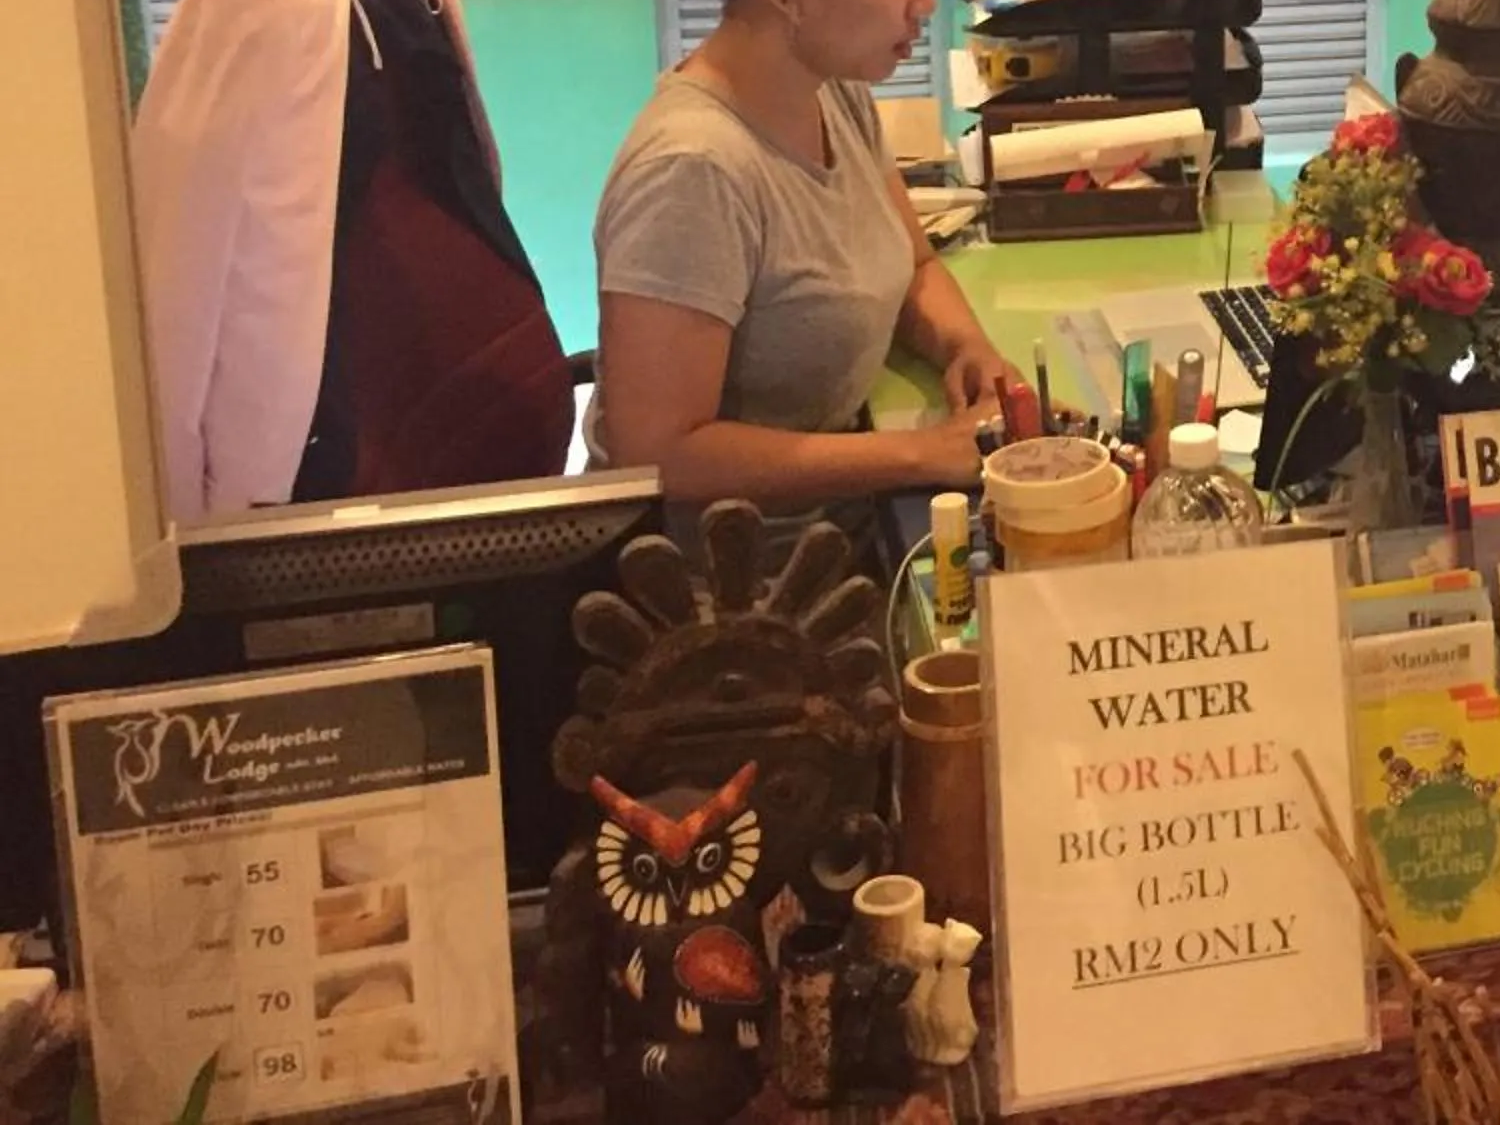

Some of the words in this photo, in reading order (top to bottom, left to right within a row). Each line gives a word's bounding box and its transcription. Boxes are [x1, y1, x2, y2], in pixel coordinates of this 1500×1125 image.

[1067, 620, 1270, 676] MINERAL
[1090, 680, 1255, 731] WATER
[166, 712, 342, 759] Woodpecker
[204, 753, 280, 784] Lodge
[1073, 754, 1160, 800] FOR
[1171, 740, 1280, 788] SALE
[1057, 824, 1128, 865] BIG
[1141, 800, 1301, 853] BOTTLE
[1418, 834, 1462, 857] FUN
[246, 860, 281, 885] 55
[1399, 852, 1486, 882] CYCLING
[1136, 866, 1231, 910] (1.5L)
[250, 925, 285, 948] 70
[1072, 939, 1163, 983] RM2
[1175, 915, 1299, 967] ONLY
[257, 990, 292, 1014] 70
[262, 1052, 297, 1076] 98
